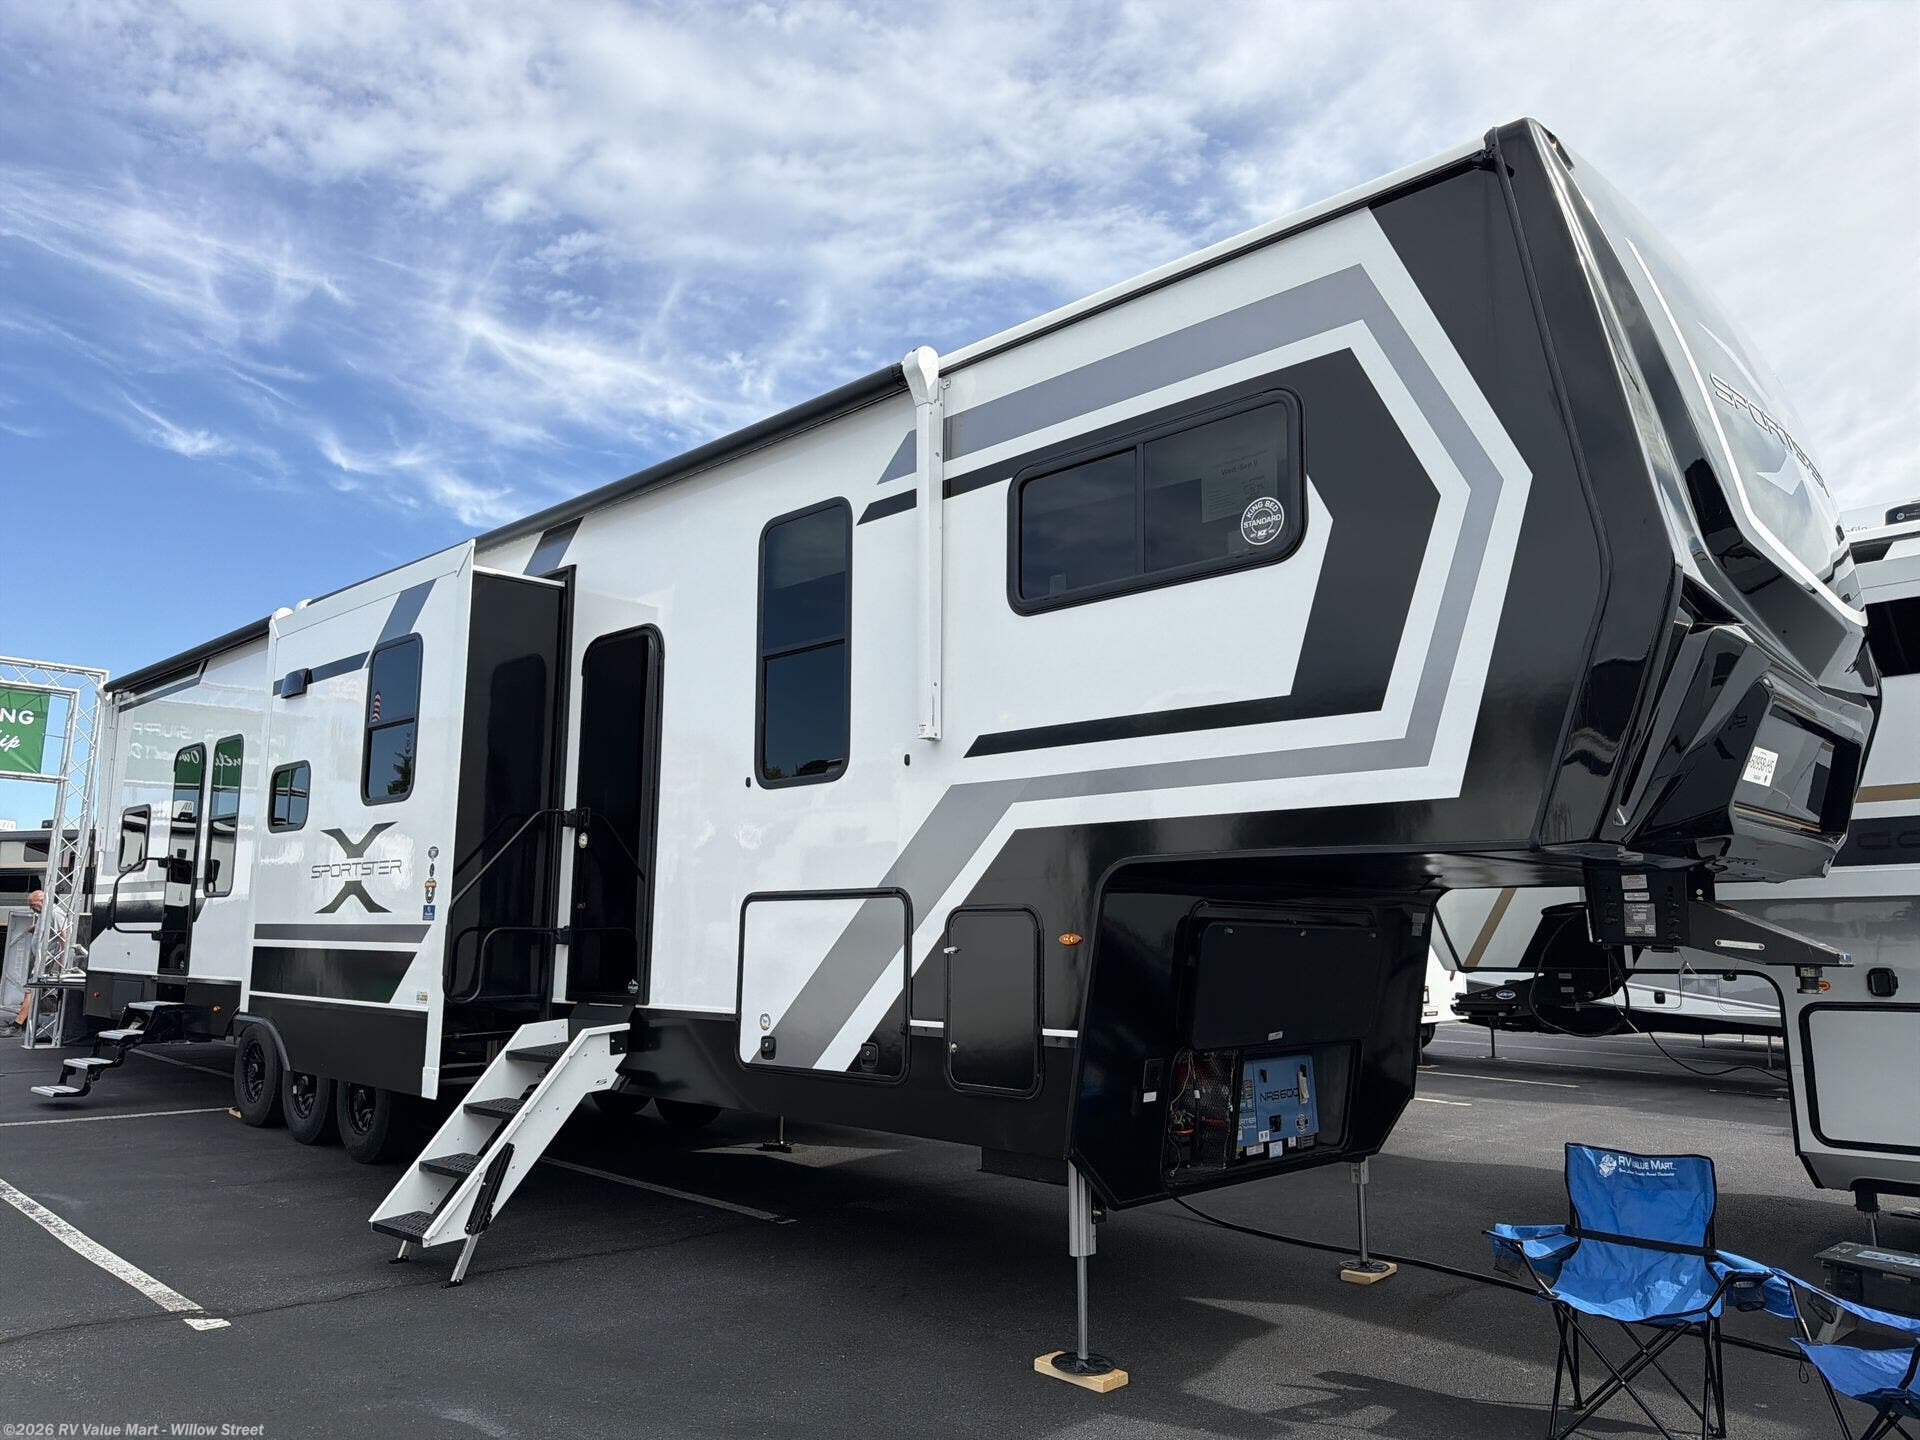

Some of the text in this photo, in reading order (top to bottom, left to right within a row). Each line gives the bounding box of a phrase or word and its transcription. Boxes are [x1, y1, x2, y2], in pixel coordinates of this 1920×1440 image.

[1709, 372, 1830, 499] SPORTSTER
[1246, 500, 1279, 518] KING BED
[1243, 513, 1282, 529] STANDARD
[0, 707, 35, 725] NG
[311, 859, 403, 879] SPORTSTER
[1618, 1155, 1632, 1168] RV
[1650, 1159, 1674, 1170] MART
